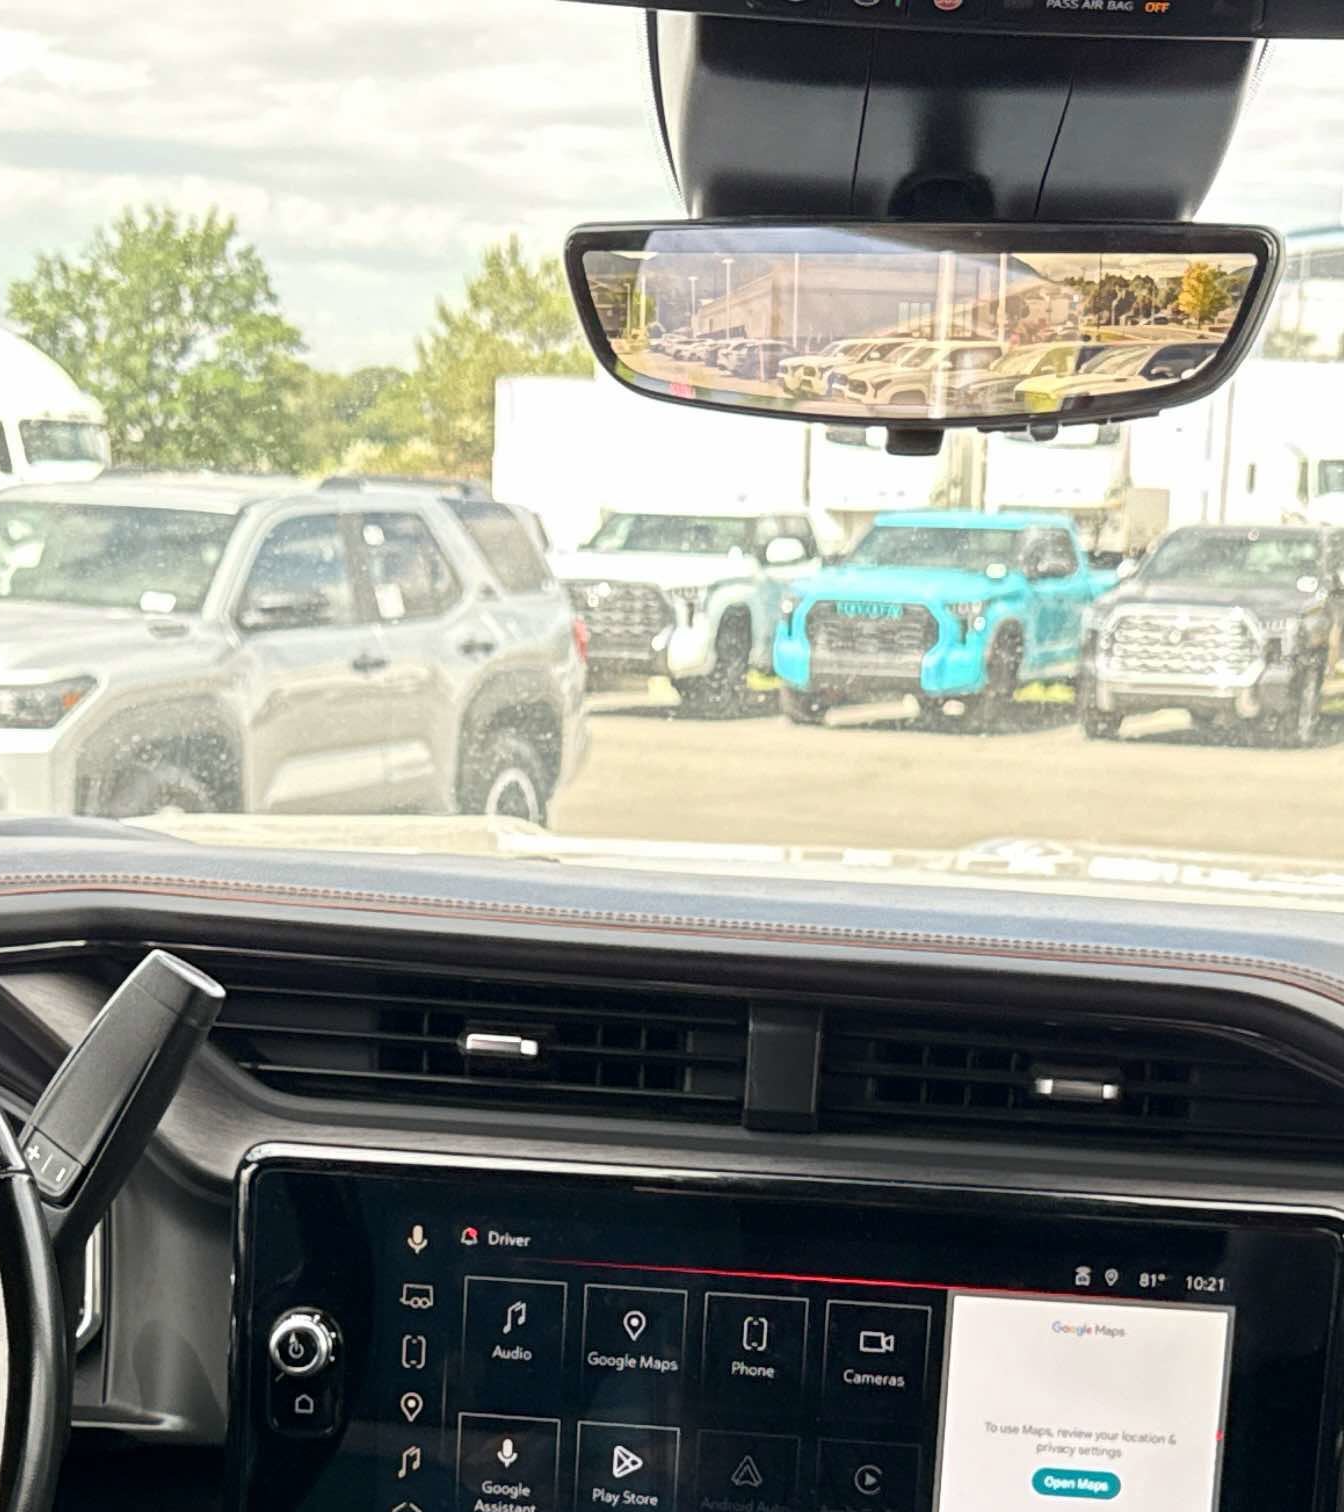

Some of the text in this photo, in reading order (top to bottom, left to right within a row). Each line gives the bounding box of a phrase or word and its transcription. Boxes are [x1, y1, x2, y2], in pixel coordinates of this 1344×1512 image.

[1046, 0, 1170, 13] PASS AIR BAG OFF
[487, 1231, 531, 1247] Driver
[1186, 1275, 1226, 1292] 10:21
[1051, 1321, 1126, 1339] Google Maps
[492, 1345, 532, 1360] Audio
[587, 1351, 678, 1373] Google Maps
[731, 1361, 775, 1379] Phone
[843, 1369, 905, 1388] Cameras
[985, 1421, 998, 1433] To
[1000, 1425, 1019, 1435] use
[1022, 1425, 1054, 1438] Maps,
[1057, 1428, 1093, 1440] review
[1095, 1431, 1119, 1443] your
[1122, 1432, 1166, 1445] location
[1036, 1442, 1122, 1459] privacy settings
[481, 1480, 531, 1499] Google
[1044, 1476, 1110, 1493] Open Maps
[592, 1488, 658, 1507] Play Store
